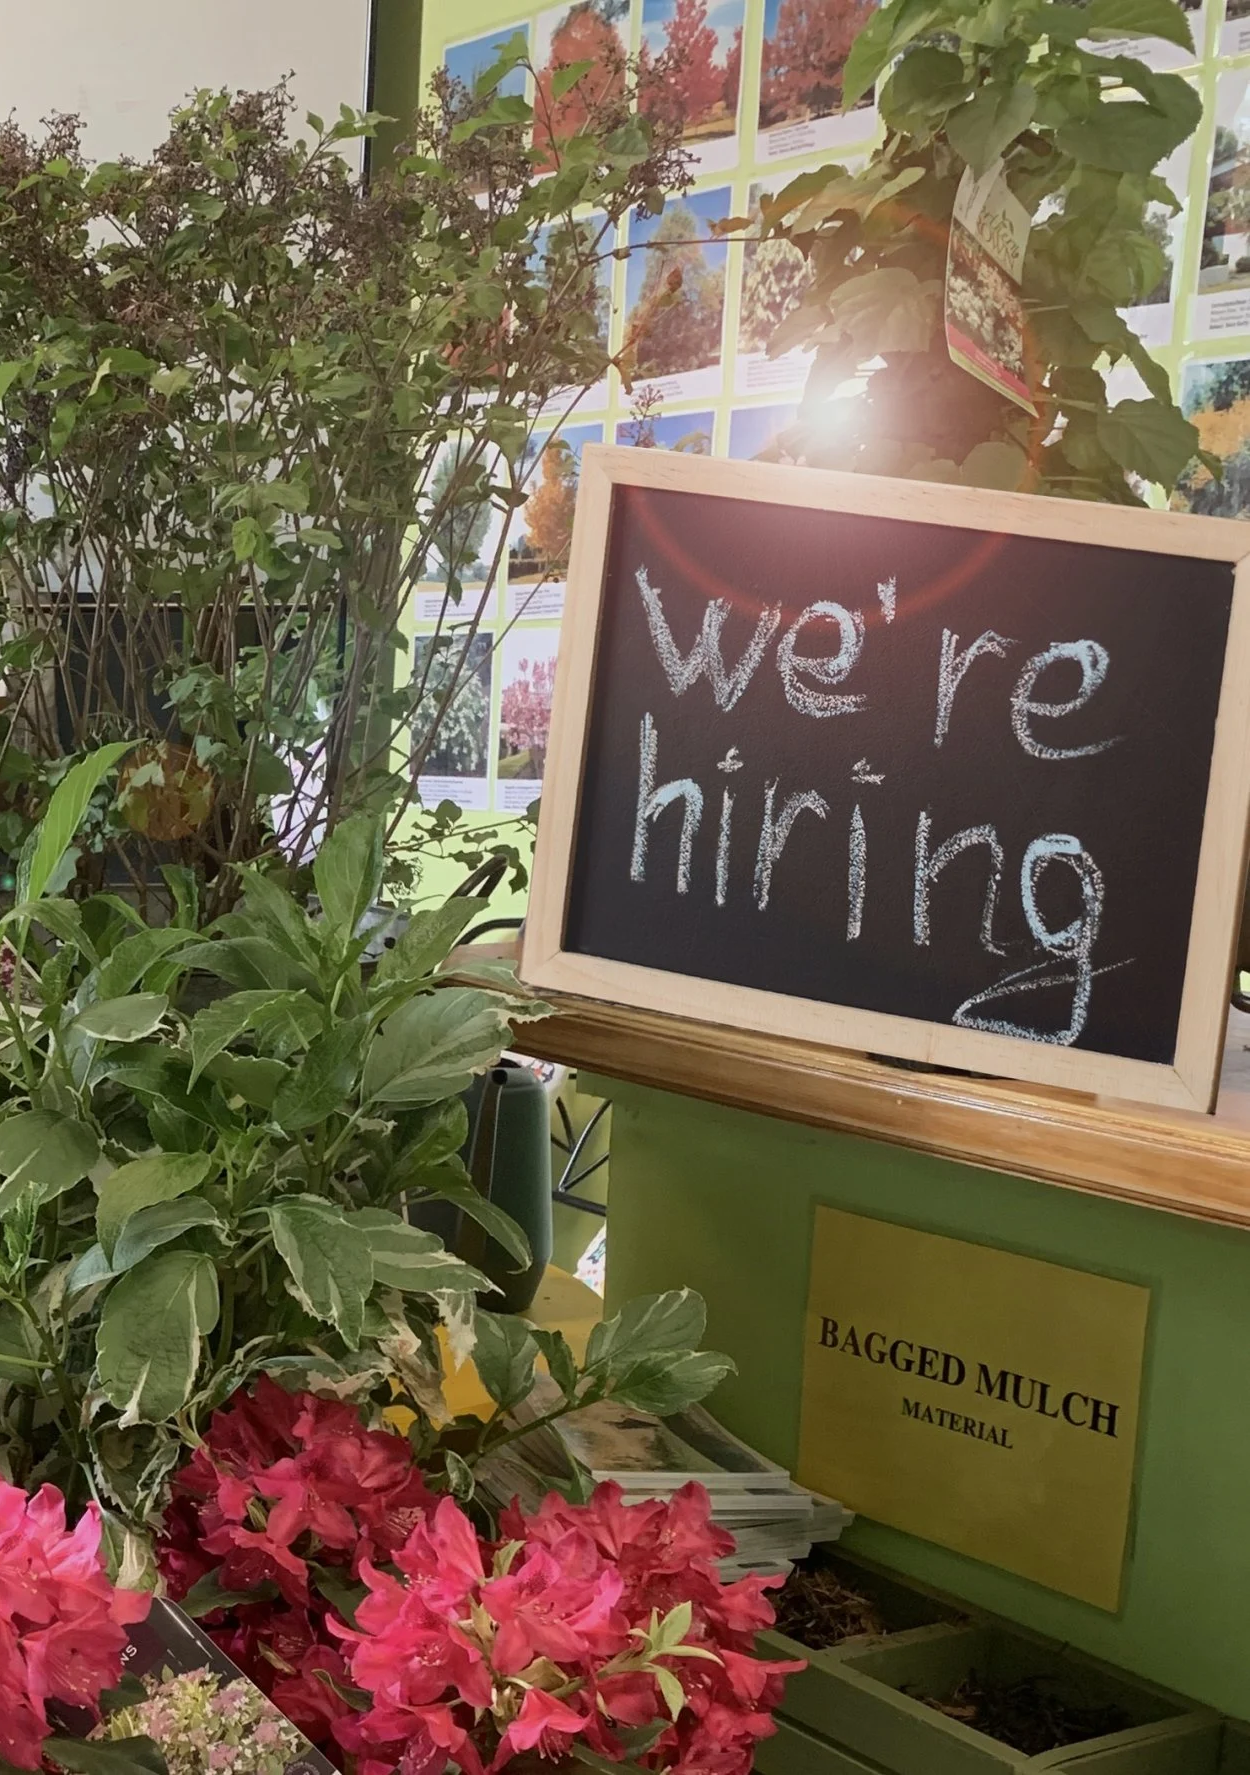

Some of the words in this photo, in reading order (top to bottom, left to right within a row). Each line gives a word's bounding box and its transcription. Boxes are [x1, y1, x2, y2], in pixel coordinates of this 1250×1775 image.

[629, 711, 1135, 1047] hiring
[818, 1316, 966, 1387] BAGGED
[974, 1362, 1120, 1439] MULCH
[900, 1396, 1014, 1450] MATERIAL
